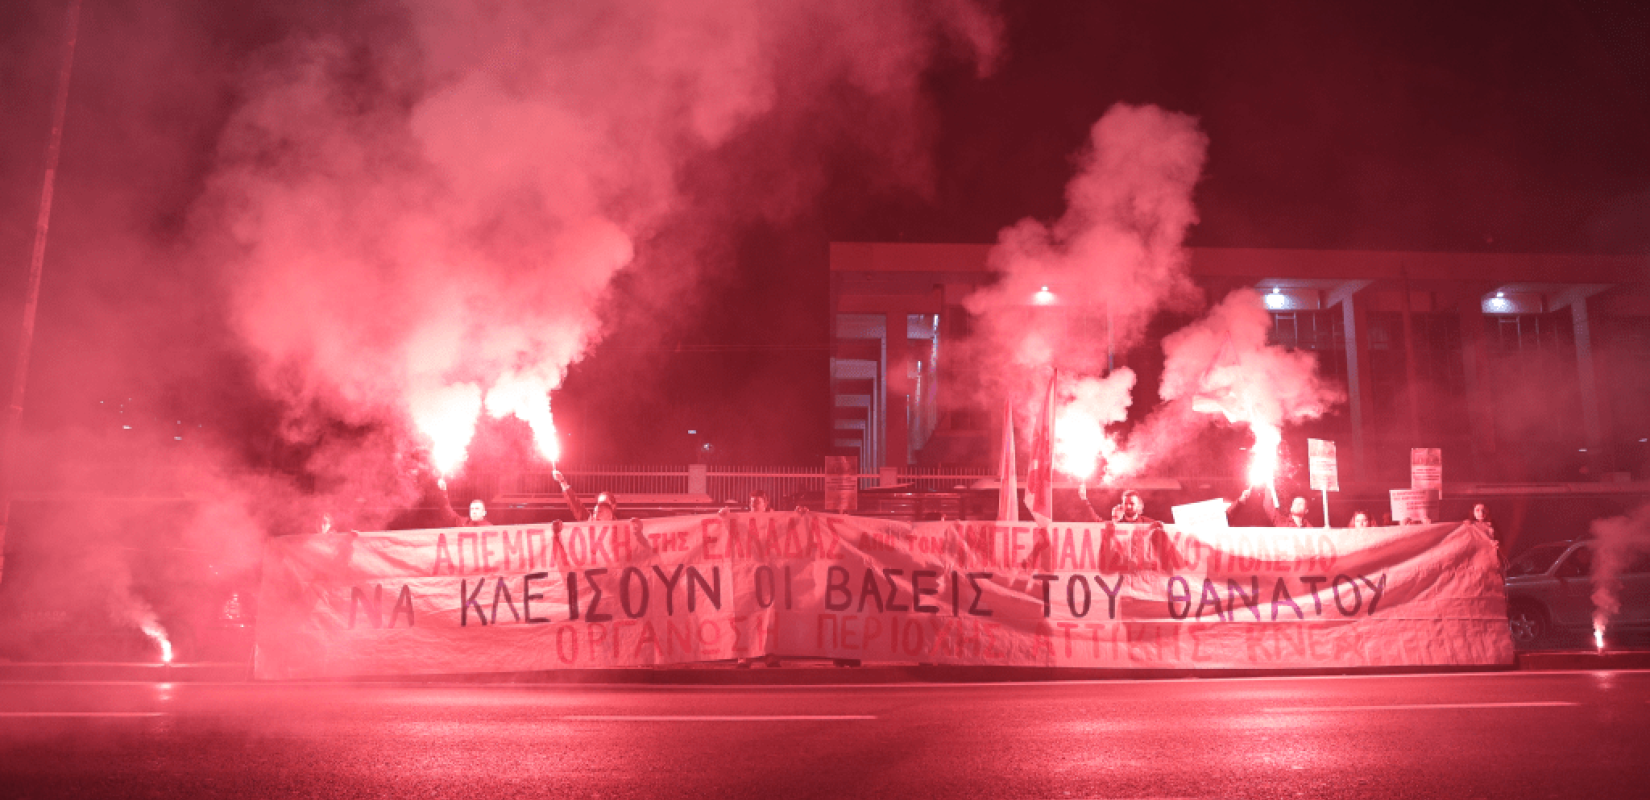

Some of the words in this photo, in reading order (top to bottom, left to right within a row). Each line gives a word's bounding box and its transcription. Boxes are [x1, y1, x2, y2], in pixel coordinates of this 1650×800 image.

[433, 524, 631, 576] ΑΠΕΜΠΛΟΚΗ
[648, 531, 689, 554] ΤΗΣ
[702, 517, 846, 561] ΕΛΛΑΔΑΣ
[1214, 533, 1337, 573] ΠΟΛΕΜΟ
[348, 584, 415, 630] ΝΑ
[460, 564, 722, 627] ΚΛΕΙΣΟΥΝ
[754, 565, 792, 610] ΟΙ
[825, 565, 994, 617] ΒΑΣΕΙΣ
[1033, 574, 1124, 620] ΤΟΥ
[1167, 573, 1387, 621] ΘΑΝΑΤΟΥ
[555, 611, 780, 664] ΟΡΓΑΝΩΣΗ
[816, 613, 1005, 659] ΠΕΡΙΟΧΗΣ
[1033, 621, 1213, 662] ΑΤΤΙΚΗΣ
